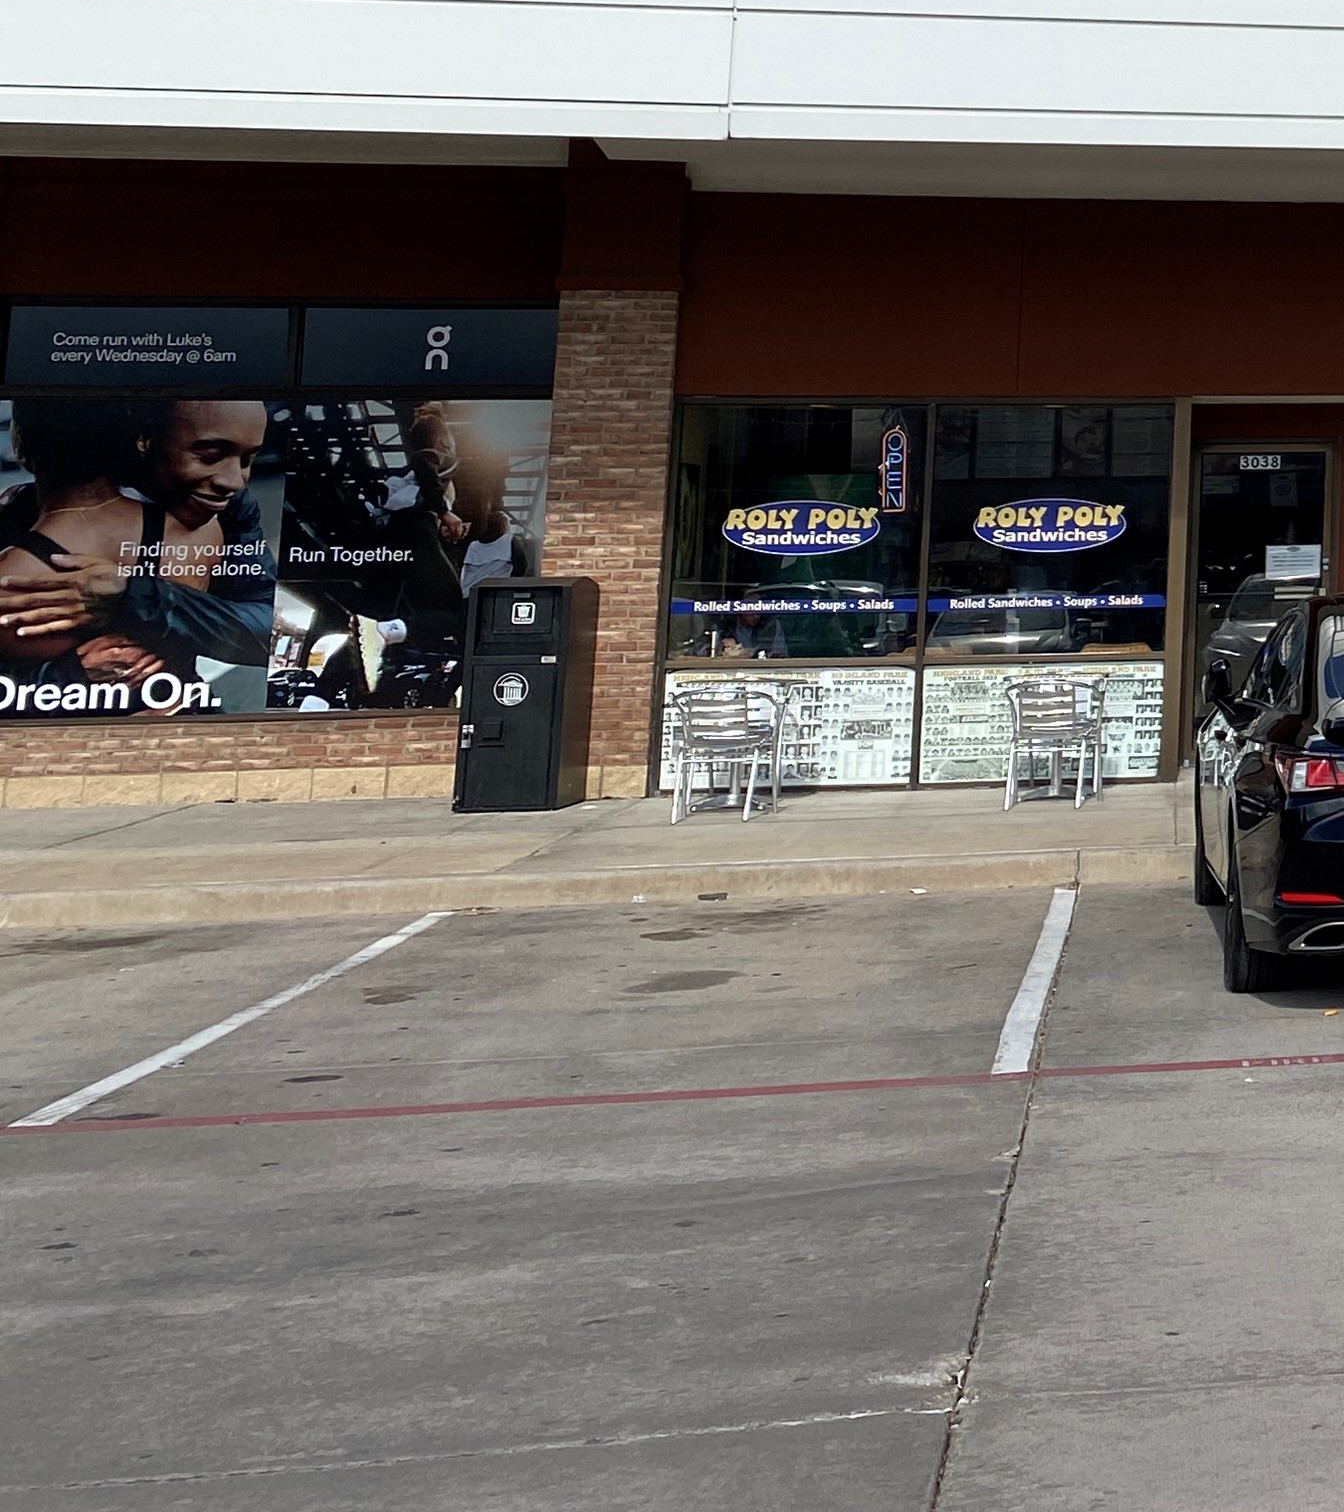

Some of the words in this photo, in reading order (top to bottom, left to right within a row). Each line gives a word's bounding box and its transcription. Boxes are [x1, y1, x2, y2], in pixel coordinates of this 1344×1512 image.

[53, 332, 99, 346] Come
[103, 335, 127, 346] run
[131, 332, 163, 346] with
[166, 332, 212, 346] Luke's
[51, 351, 92, 365] every
[96, 349, 183, 365] Wednesday
[186, 350, 200, 364] @
[203, 349, 237, 362] 6am
[887, 433, 904, 507] OPEN
[1241, 456, 1279, 468] 3038
[726, 508, 799, 530] ROLY
[808, 507, 878, 530] POLY
[977, 506, 1047, 528] ROLY
[1056, 504, 1125, 528] POLY
[741, 531, 861, 545] Sandwiches
[992, 528, 1108, 543] Sandwiches
[120, 541, 189, 560] Finding
[193, 540, 267, 559] yourself
[289, 547, 325, 562] Run
[330, 546, 415, 566] Together.
[117, 561, 155, 577] isn't
[159, 562, 207, 577] done
[211, 561, 267, 577] alone.
[694, 601, 730, 612] Rolled
[733, 600, 800, 612] Sandwiches
[811, 600, 846, 612] Soups
[858, 599, 894, 610] Salads
[950, 599, 985, 609] Rolled
[987, 597, 1053, 609] Sandwiches
[1063, 596, 1097, 609] Soups
[1108, 595, 1144, 606] Salads
[141, 672, 222, 709] On.
